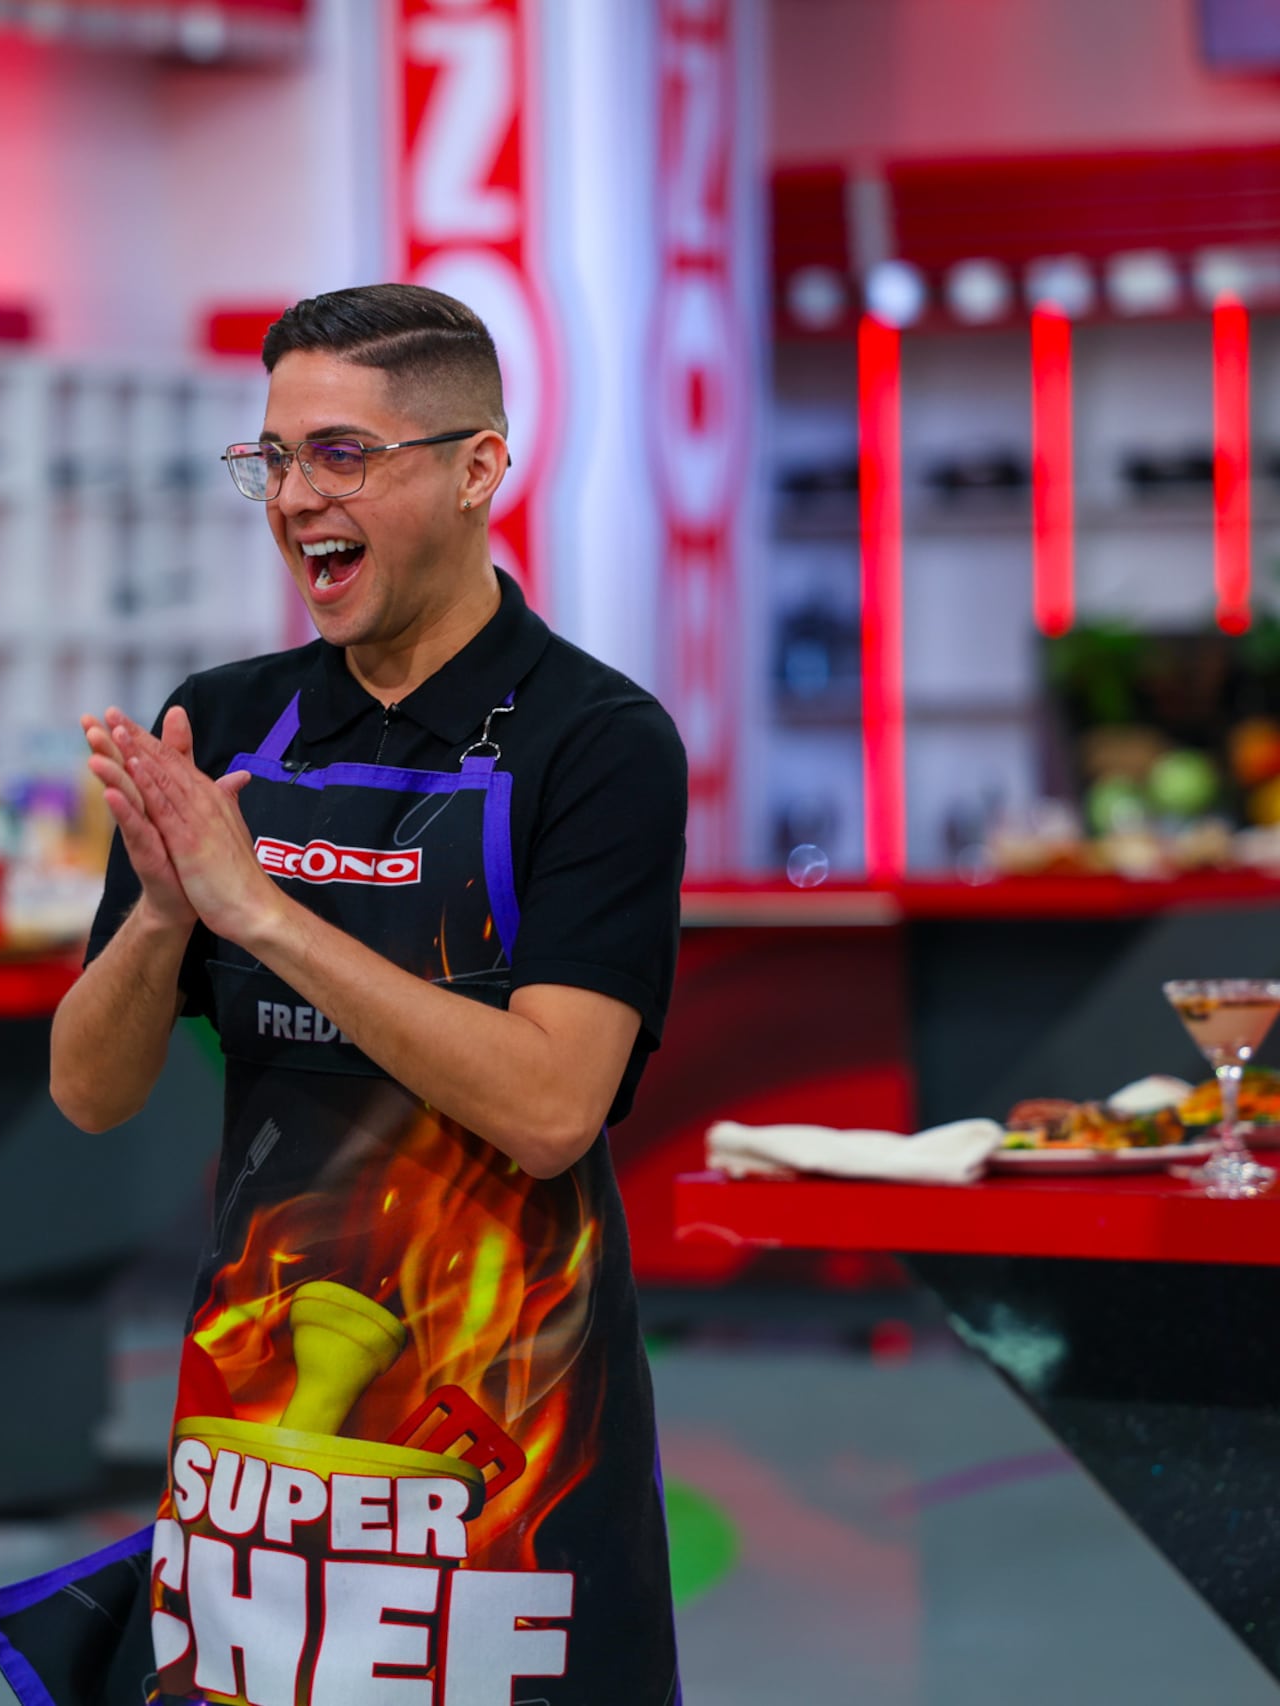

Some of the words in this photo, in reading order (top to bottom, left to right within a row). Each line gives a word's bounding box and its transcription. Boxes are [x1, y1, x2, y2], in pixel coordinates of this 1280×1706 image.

[256, 844, 416, 879] ECONO
[257, 1000, 354, 1044] FRED
[172, 1438, 469, 1558] SUPER
